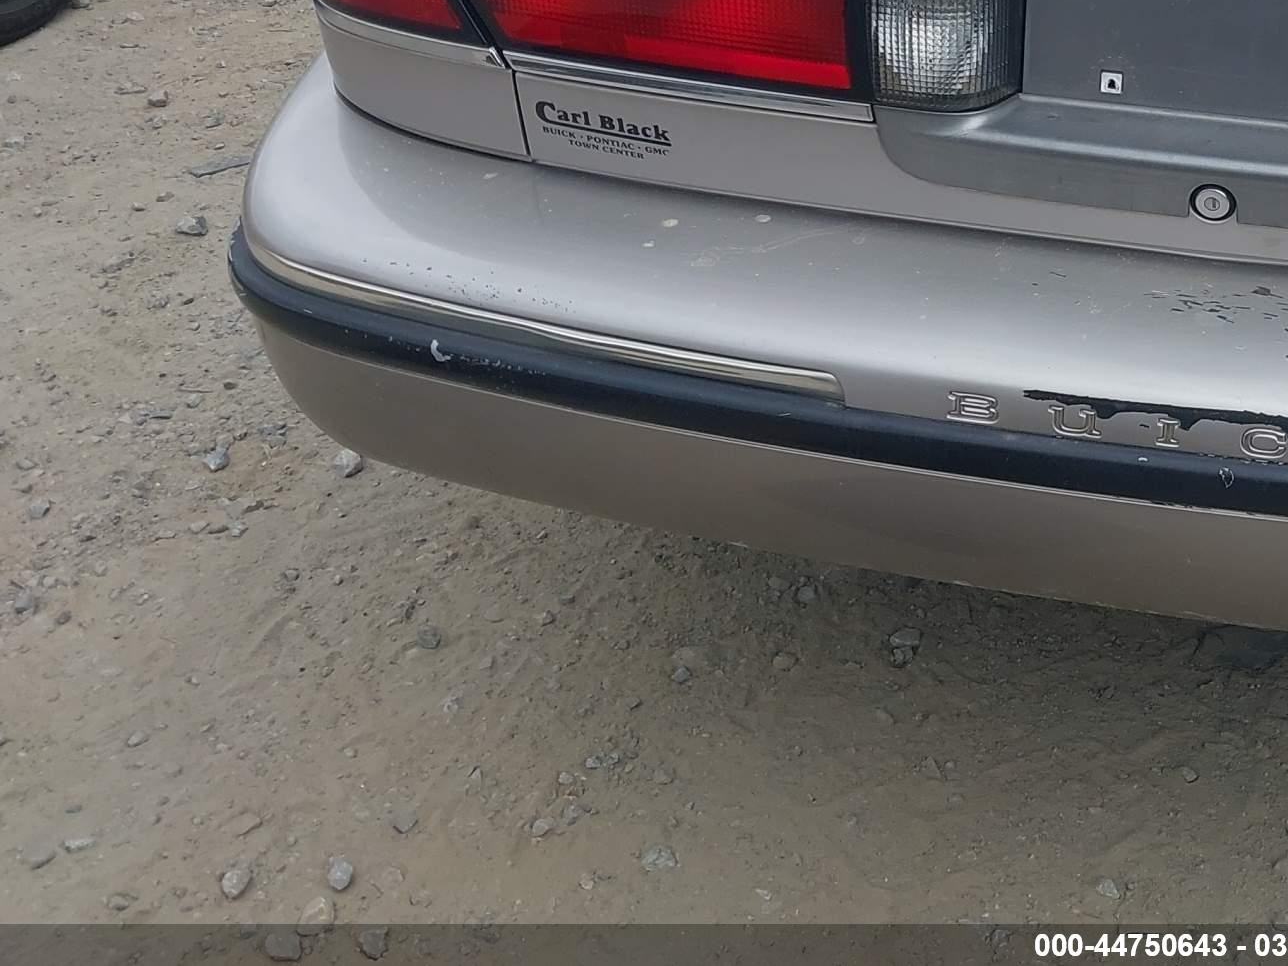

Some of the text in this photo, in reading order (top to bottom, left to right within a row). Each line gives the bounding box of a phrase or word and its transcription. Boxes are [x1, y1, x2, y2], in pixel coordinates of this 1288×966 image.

[535, 101, 670, 141] Carl Black
[542, 126, 670, 156] BUICK PONTIAC GMC
[568, 139, 644, 159] TOWN CENTER
